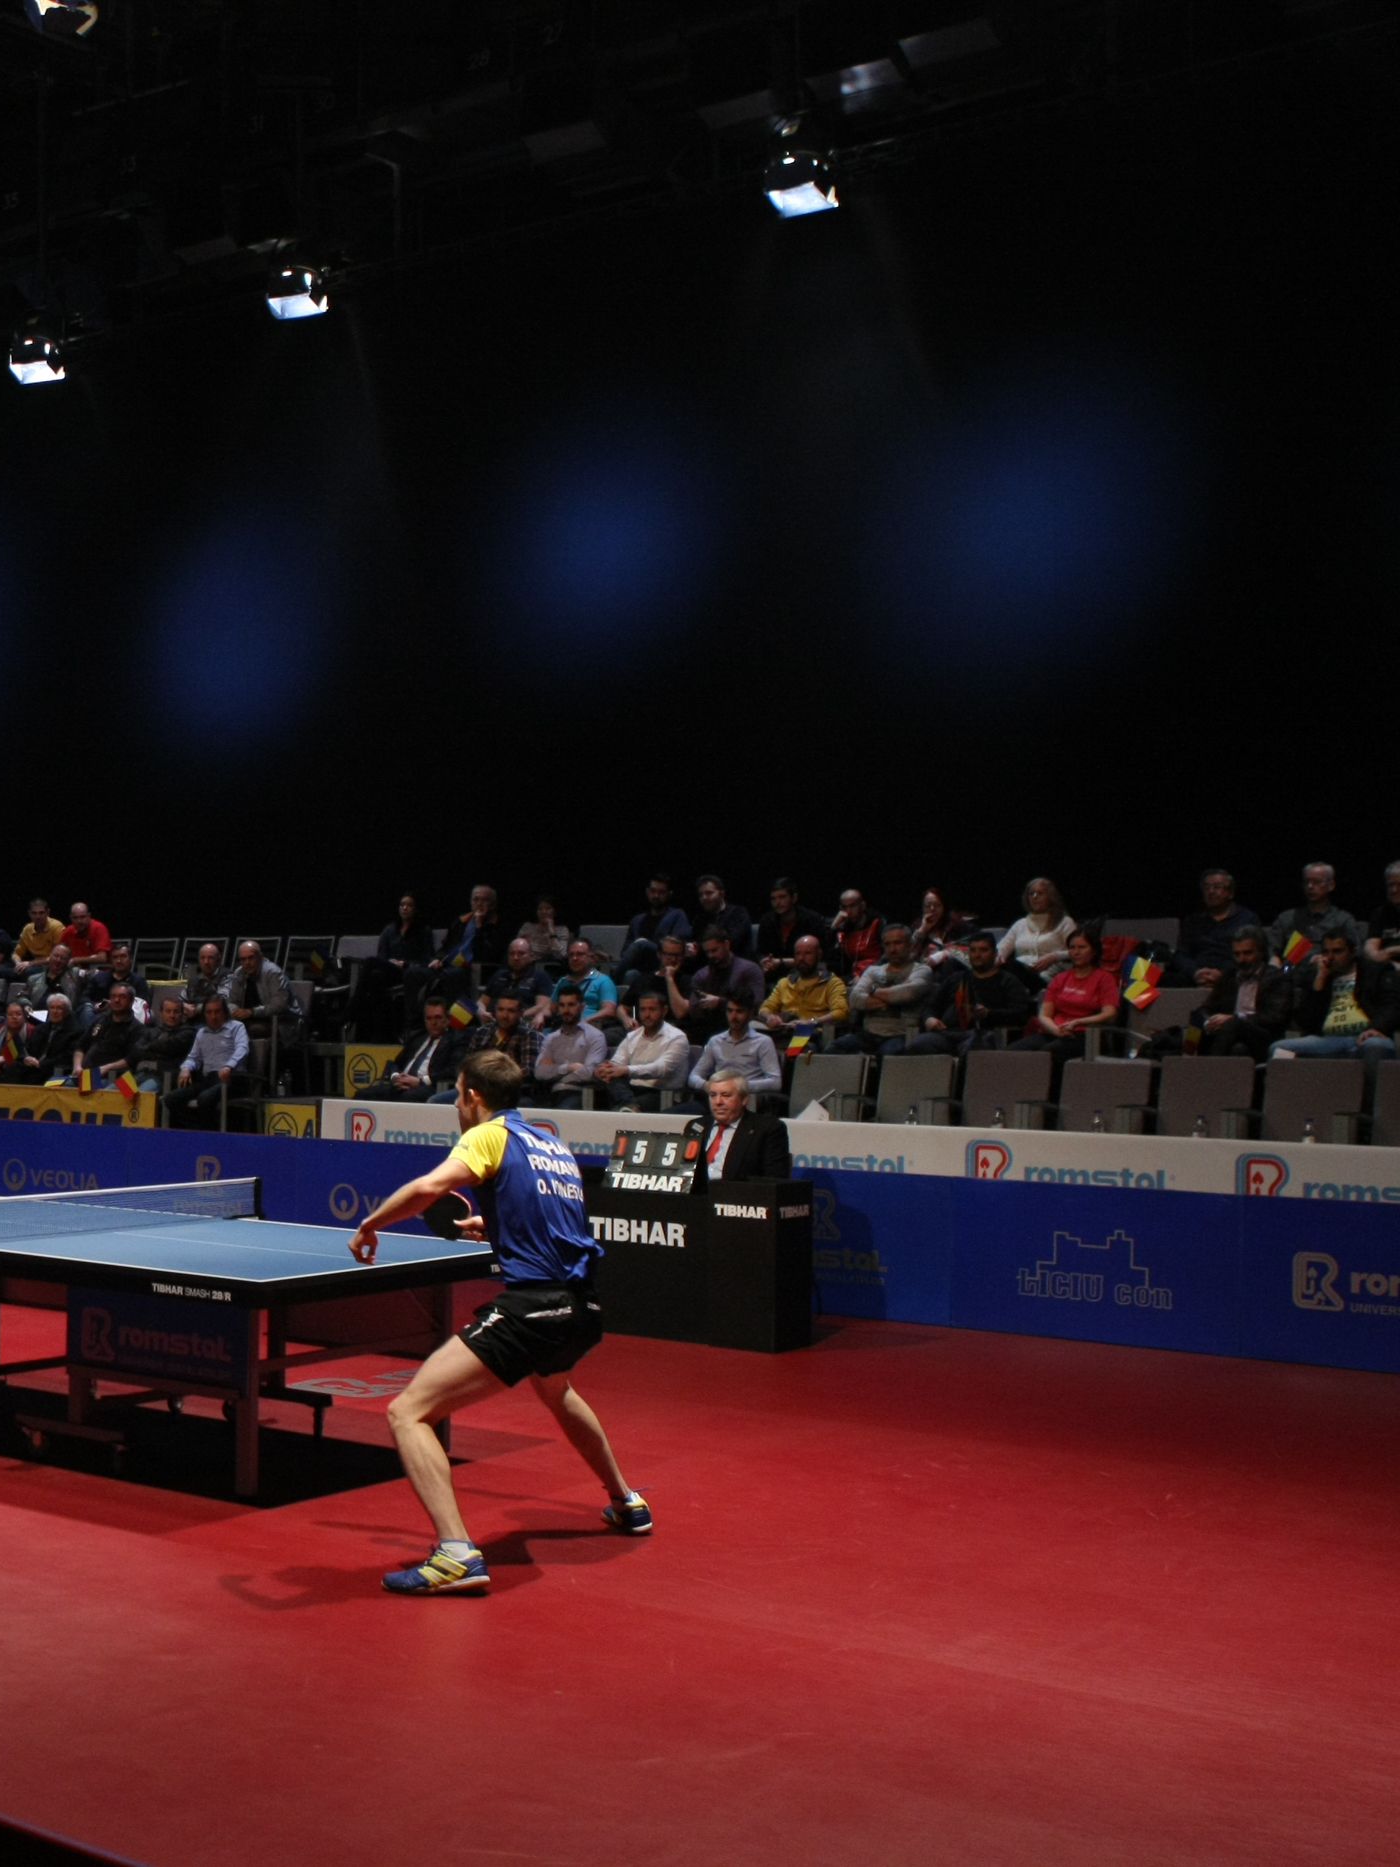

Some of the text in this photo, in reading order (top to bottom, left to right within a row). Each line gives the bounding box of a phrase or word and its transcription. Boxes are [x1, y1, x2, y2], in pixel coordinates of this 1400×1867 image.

[384, 1129, 462, 1147] romst
[632, 1140, 648, 1164] 5
[662, 1142, 678, 1166] 5
[684, 1139, 700, 1160] 0
[790, 1154, 905, 1173] omstal
[29, 1168, 99, 1190] VEOLIA
[611, 1172, 684, 1193] TIBHAR
[714, 1203, 768, 1220] TIBHAR
[779, 1203, 811, 1219] TIBHAR
[589, 1215, 686, 1248] TIBHAR
[151, 1282, 184, 1296] TIBHAR
[184, 1286, 211, 1299] SMASH
